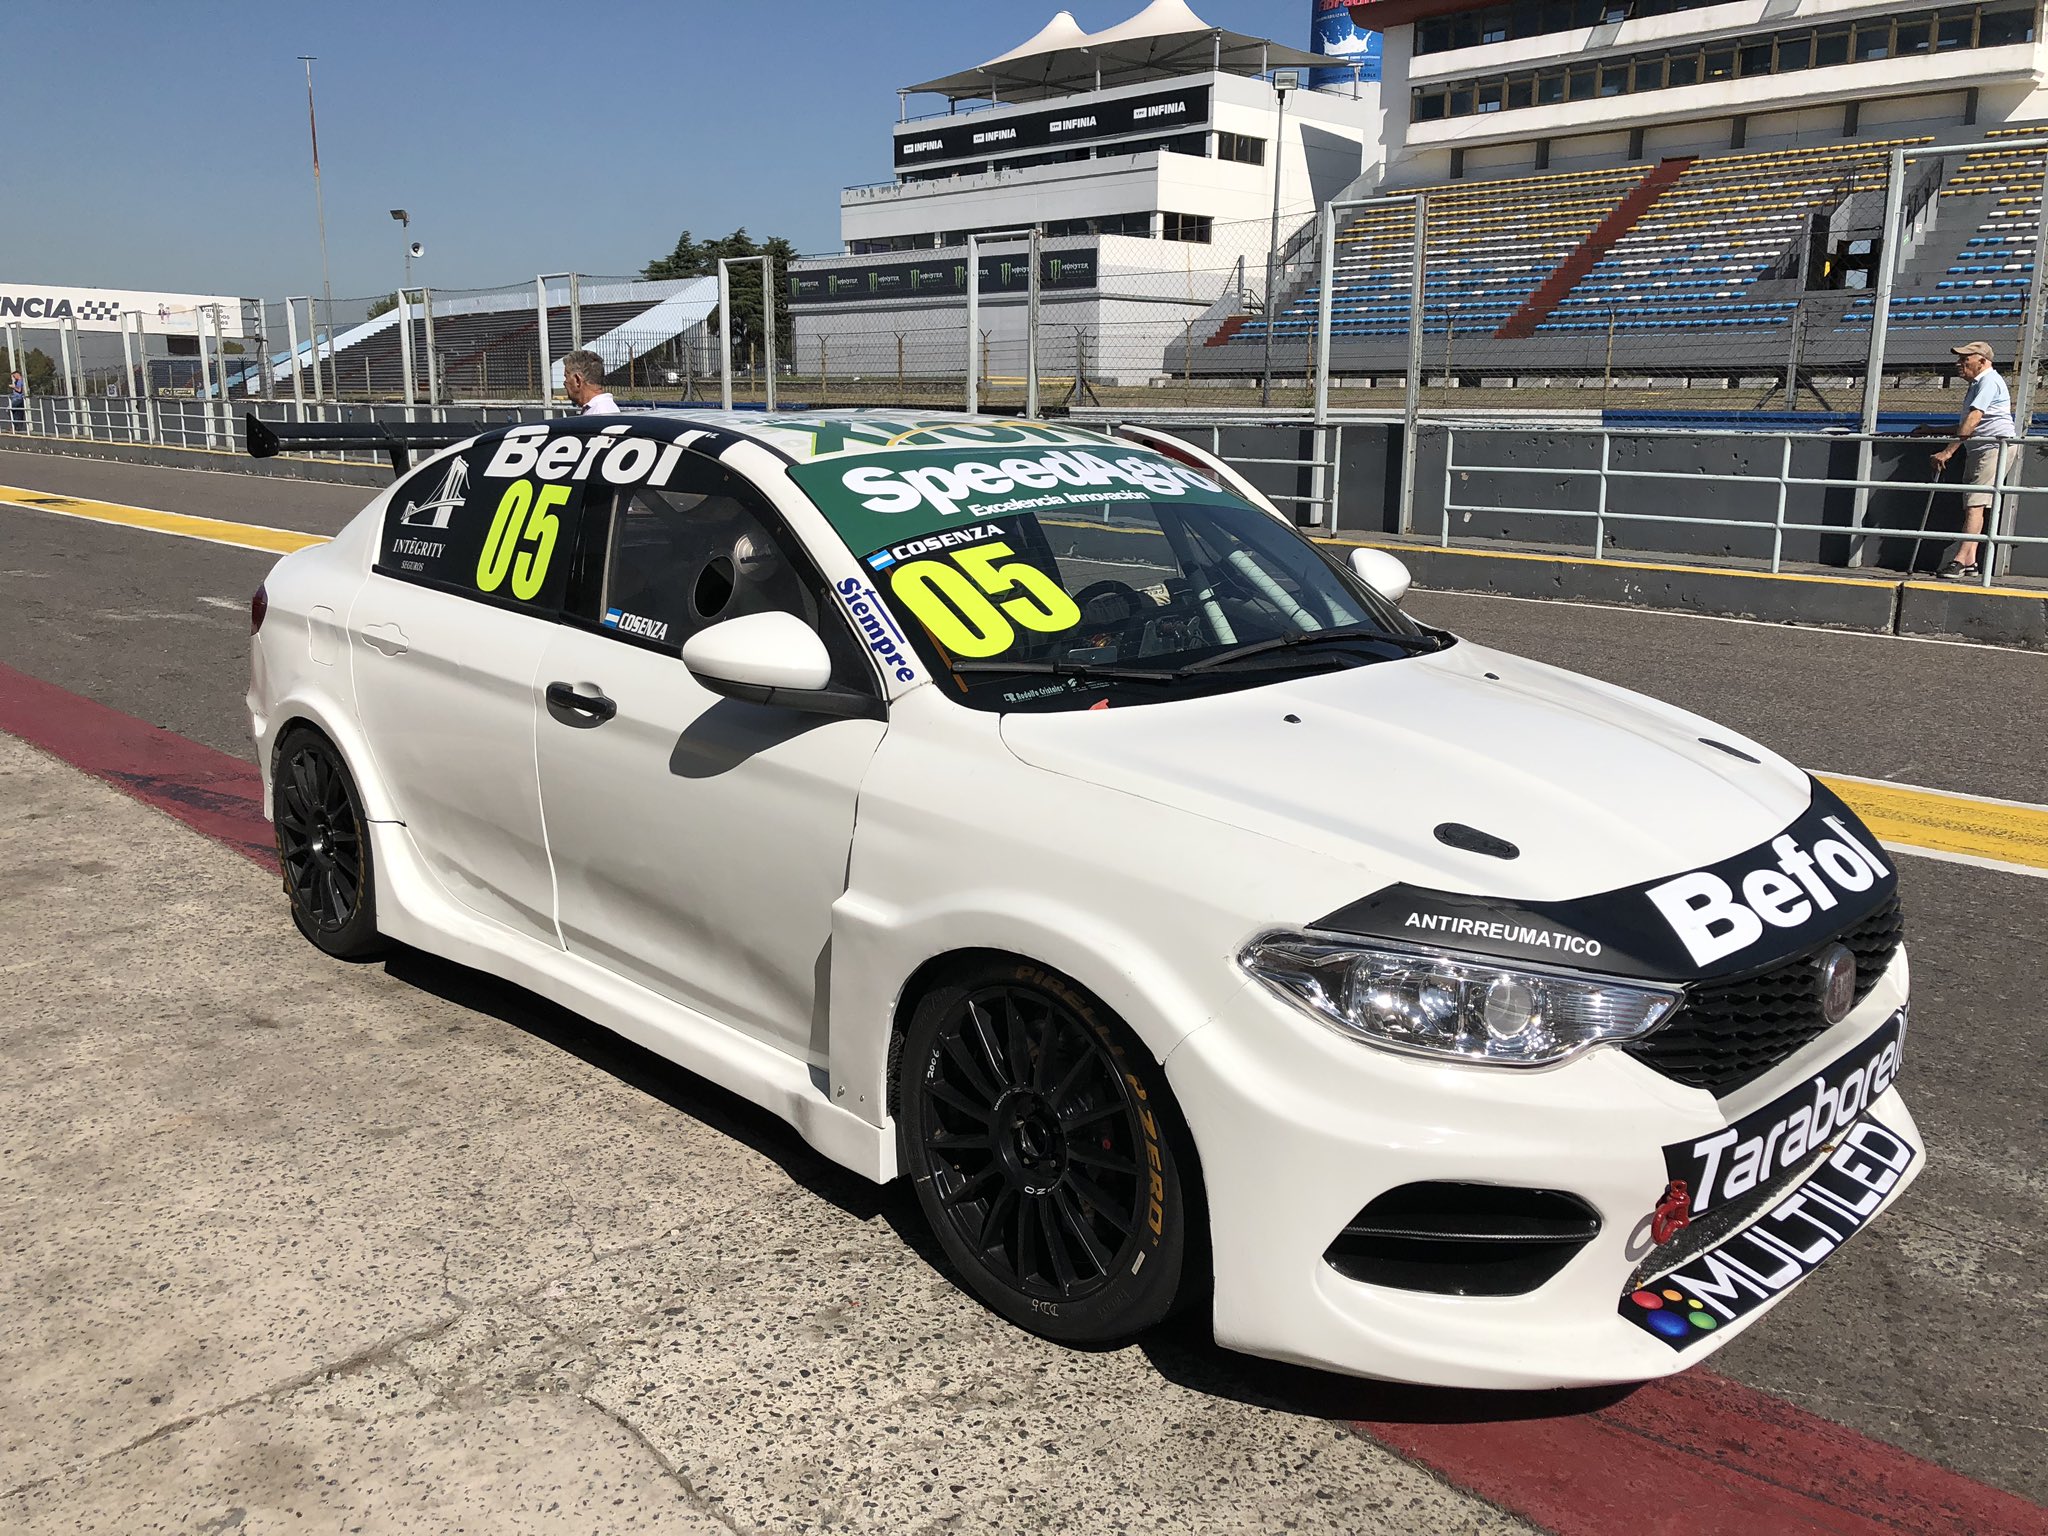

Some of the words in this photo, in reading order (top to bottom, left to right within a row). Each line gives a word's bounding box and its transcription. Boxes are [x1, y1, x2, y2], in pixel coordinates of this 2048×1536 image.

[1062, 115, 1097, 130] INFINIA
[1148, 101, 1186, 117] INFINIA
[914, 139, 943, 153] INFINIA
[985, 128, 1017, 142] INFINIA
[483, 424, 709, 487] Befol
[842, 450, 1222, 516] SpeedAgro
[967, 494, 1066, 517] Excelencia
[1067, 489, 1150, 503] Innovación
[476, 479, 572, 600] 05
[892, 524, 1005, 561] COSENZA
[400, 560, 425, 571] SEGUROS
[891, 542, 1081, 657] 05
[618, 612, 669, 641] COSENZA
[837, 577, 914, 682] Siempre
[1645, 815, 1890, 968] Befol
[1405, 912, 1601, 957] ANTIRREUMATICO
[1138, 1106, 1164, 1236] ZERO
[1669, 1122, 1911, 1320] MULTILED
